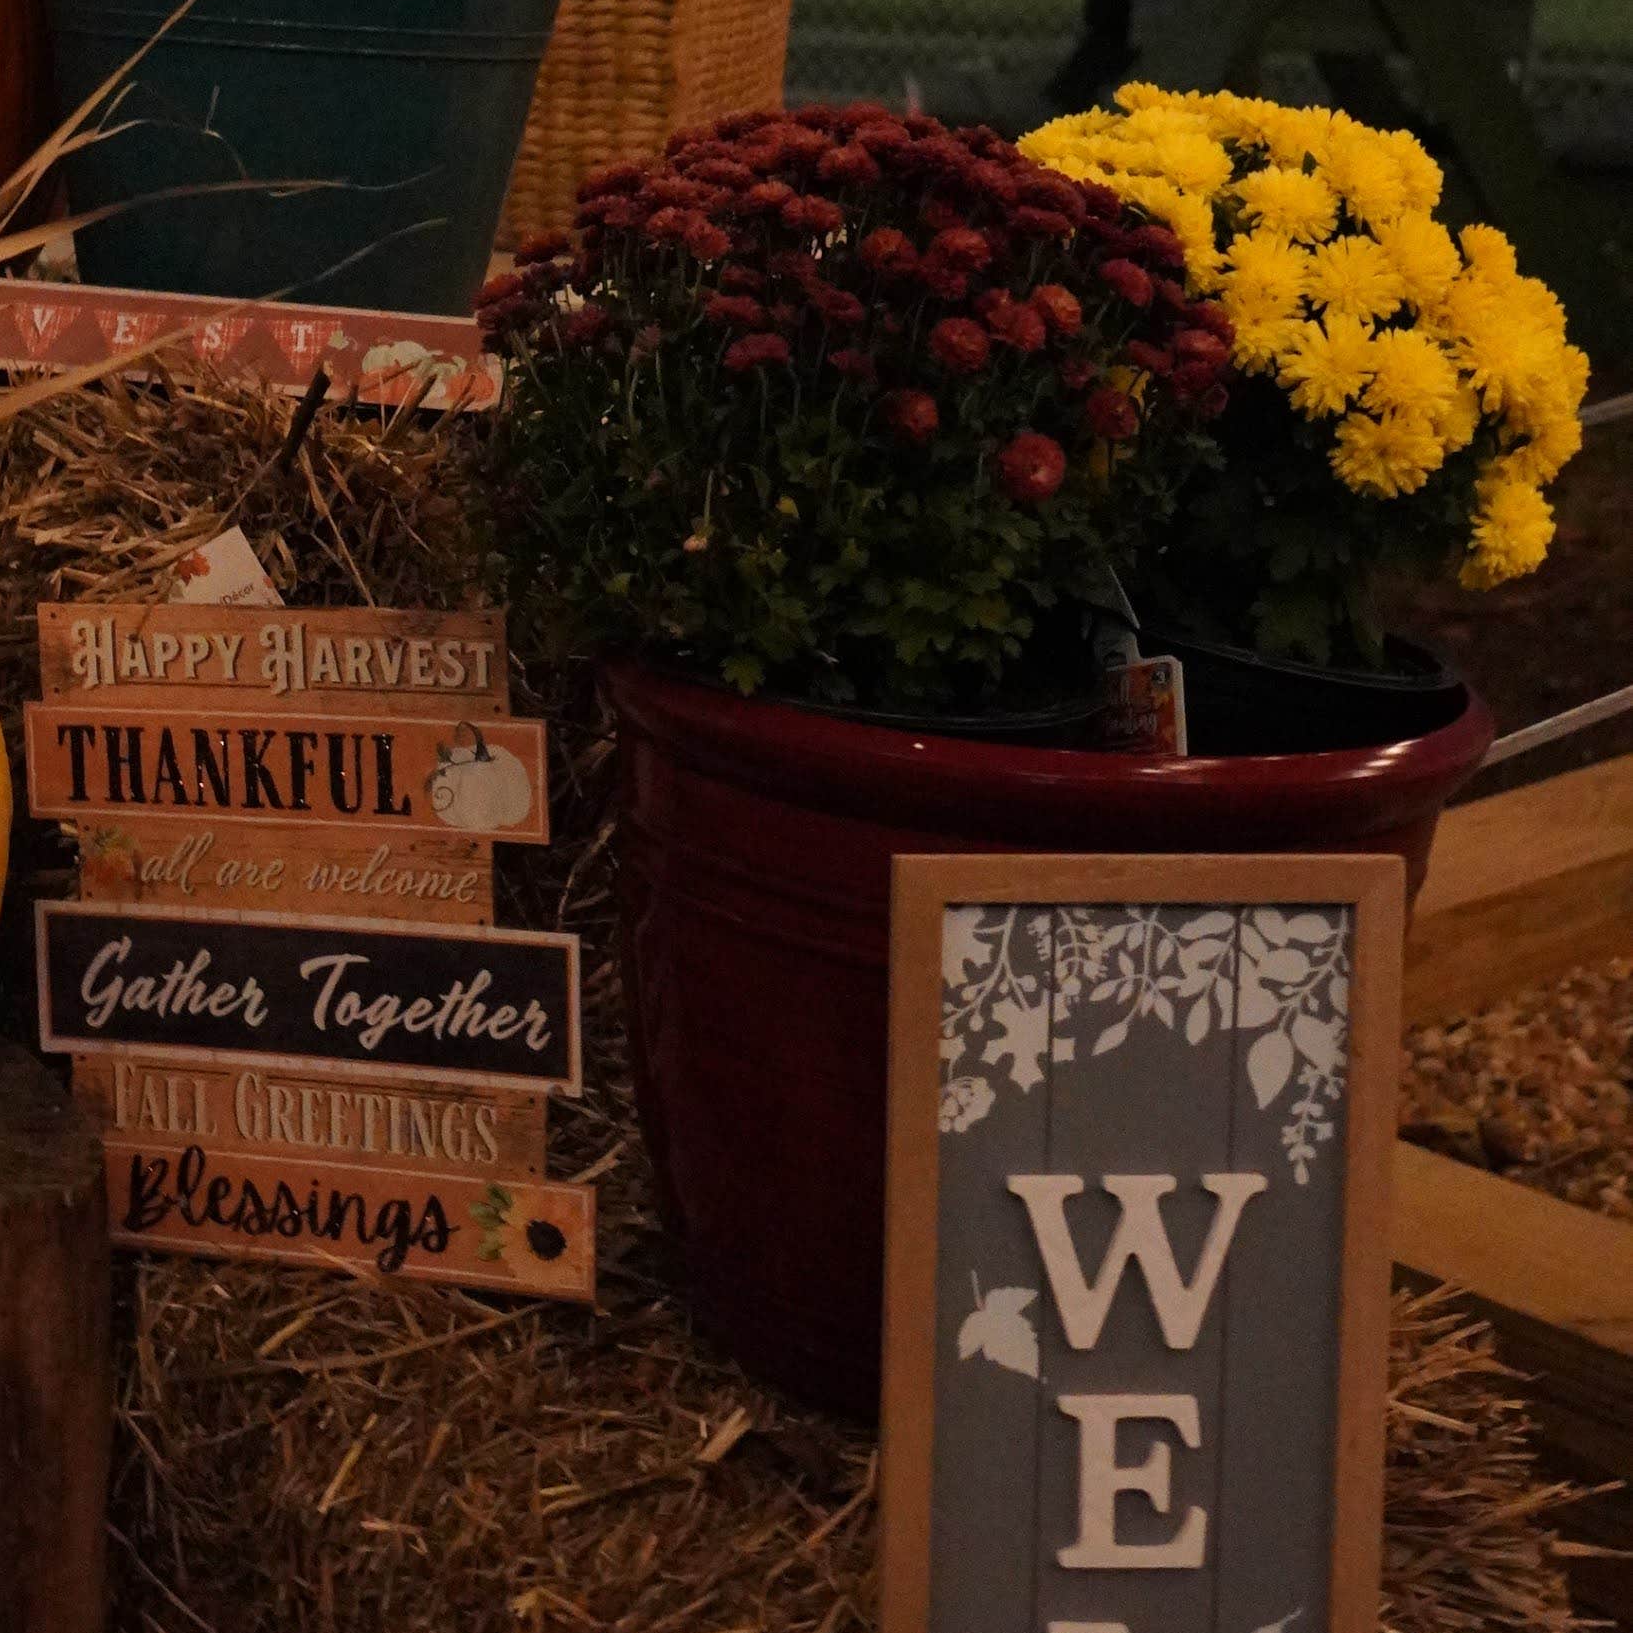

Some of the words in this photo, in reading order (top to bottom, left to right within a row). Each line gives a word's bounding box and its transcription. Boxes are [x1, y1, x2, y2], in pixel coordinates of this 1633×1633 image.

[72, 617, 246, 691] HAPPY
[260, 622, 496, 697] HARVEST
[56, 723, 413, 817] THANKFUL
[140, 833, 216, 896] all
[215, 852, 286, 894] are
[304, 843, 478, 905] welcome
[80, 935, 269, 1030] Gather
[299, 952, 551, 1052] Together
[112, 1064, 218, 1136] FALL
[234, 1072, 499, 1166] GREETINGS
[126, 1144, 461, 1273] Blessings
